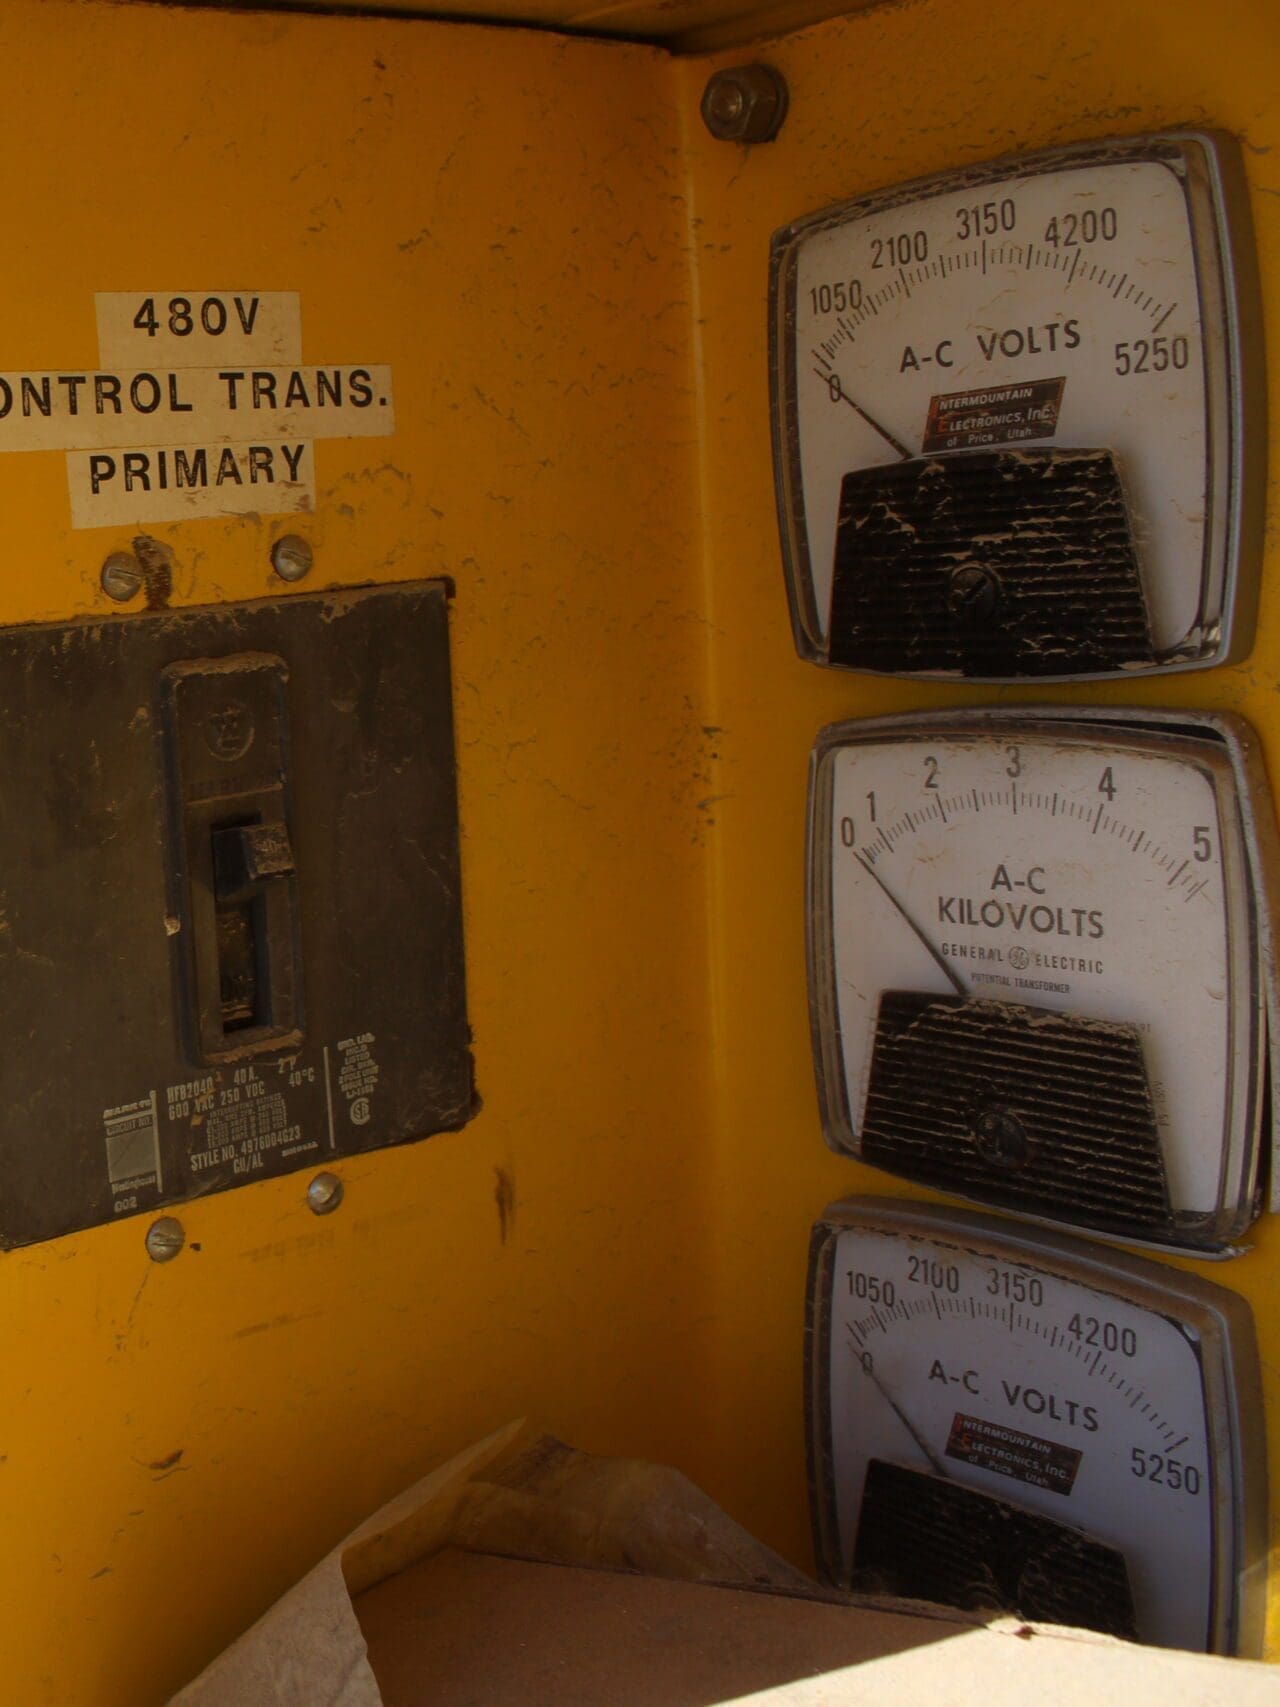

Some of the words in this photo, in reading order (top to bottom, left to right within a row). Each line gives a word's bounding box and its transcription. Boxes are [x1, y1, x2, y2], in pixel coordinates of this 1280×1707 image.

[956, 198, 1016, 241] 3150
[1044, 207, 1118, 249] 4200
[870, 230, 929, 270] 2100
[809, 279, 863, 315] 1050
[132, 297, 260, 338] 480V
[899, 340, 954, 373] A-C
[976, 319, 1081, 361] VOLTS
[1114, 336, 1189, 376] 5250
[218, 369, 387, 410] TRANS.
[827, 374, 842, 403] 0
[89, 444, 305, 495] PRIMARY
[923, 756, 939, 789] 2
[1005, 747, 1021, 779] 3
[1098, 766, 1117, 801] 4
[866, 790, 877, 823] 1
[841, 816, 855, 848] 0
[1192, 825, 1211, 862] 5
[990, 864, 1046, 896] A-C
[938, 896, 1104, 939] KILOVOLTS
[942, 942, 1004, 963] GENERAL
[1035, 952, 1105, 975] ELECTRIC
[168, 1101, 189, 1120] 600
[221, 1087, 240, 1106] 250
[245, 1081, 265, 1097] VDC
[190, 1148, 220, 1171] STYLE
[222, 1144, 238, 1160] NO.
[846, 1270, 895, 1308] 1050
[908, 1255, 959, 1294] 2100
[986, 1268, 1044, 1307] 3150
[1068, 1312, 1137, 1358] 4200
[928, 1359, 981, 1395] A-C
[1001, 1380, 1100, 1433] VOLTS
[1131, 1447, 1200, 1496] 5250
